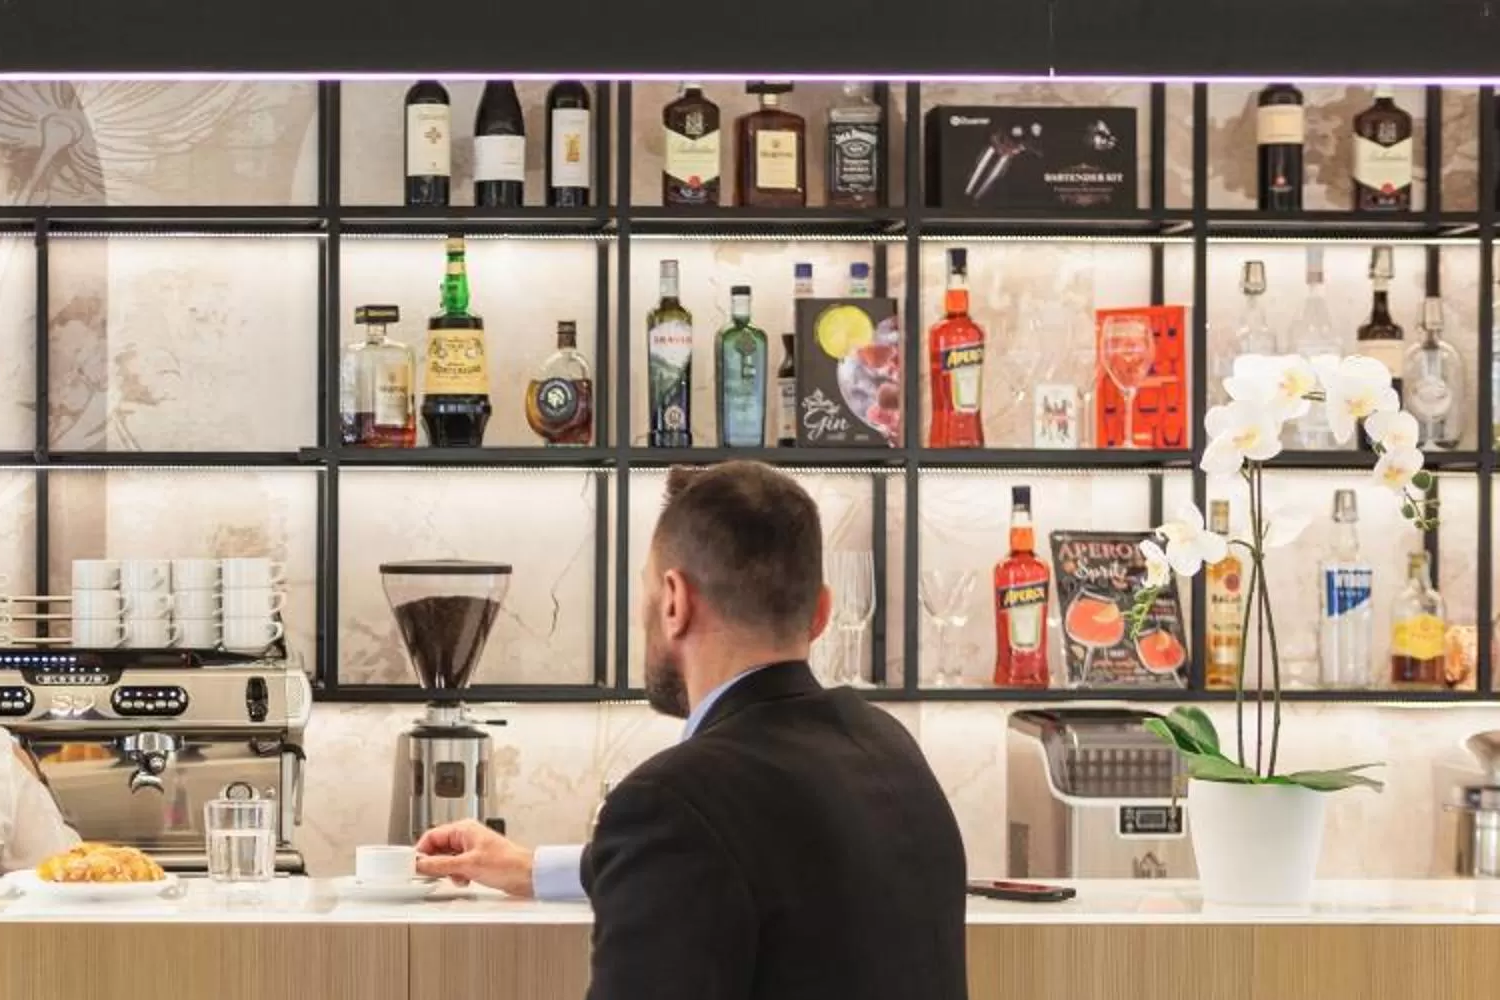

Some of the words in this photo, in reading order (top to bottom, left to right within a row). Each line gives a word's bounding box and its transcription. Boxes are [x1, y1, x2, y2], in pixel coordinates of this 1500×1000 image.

[1044, 173, 1104, 183] BARTENDER
[1106, 173, 1124, 183] KIT
[803, 407, 850, 441] Gin
[1073, 559, 1128, 583] Spritz
